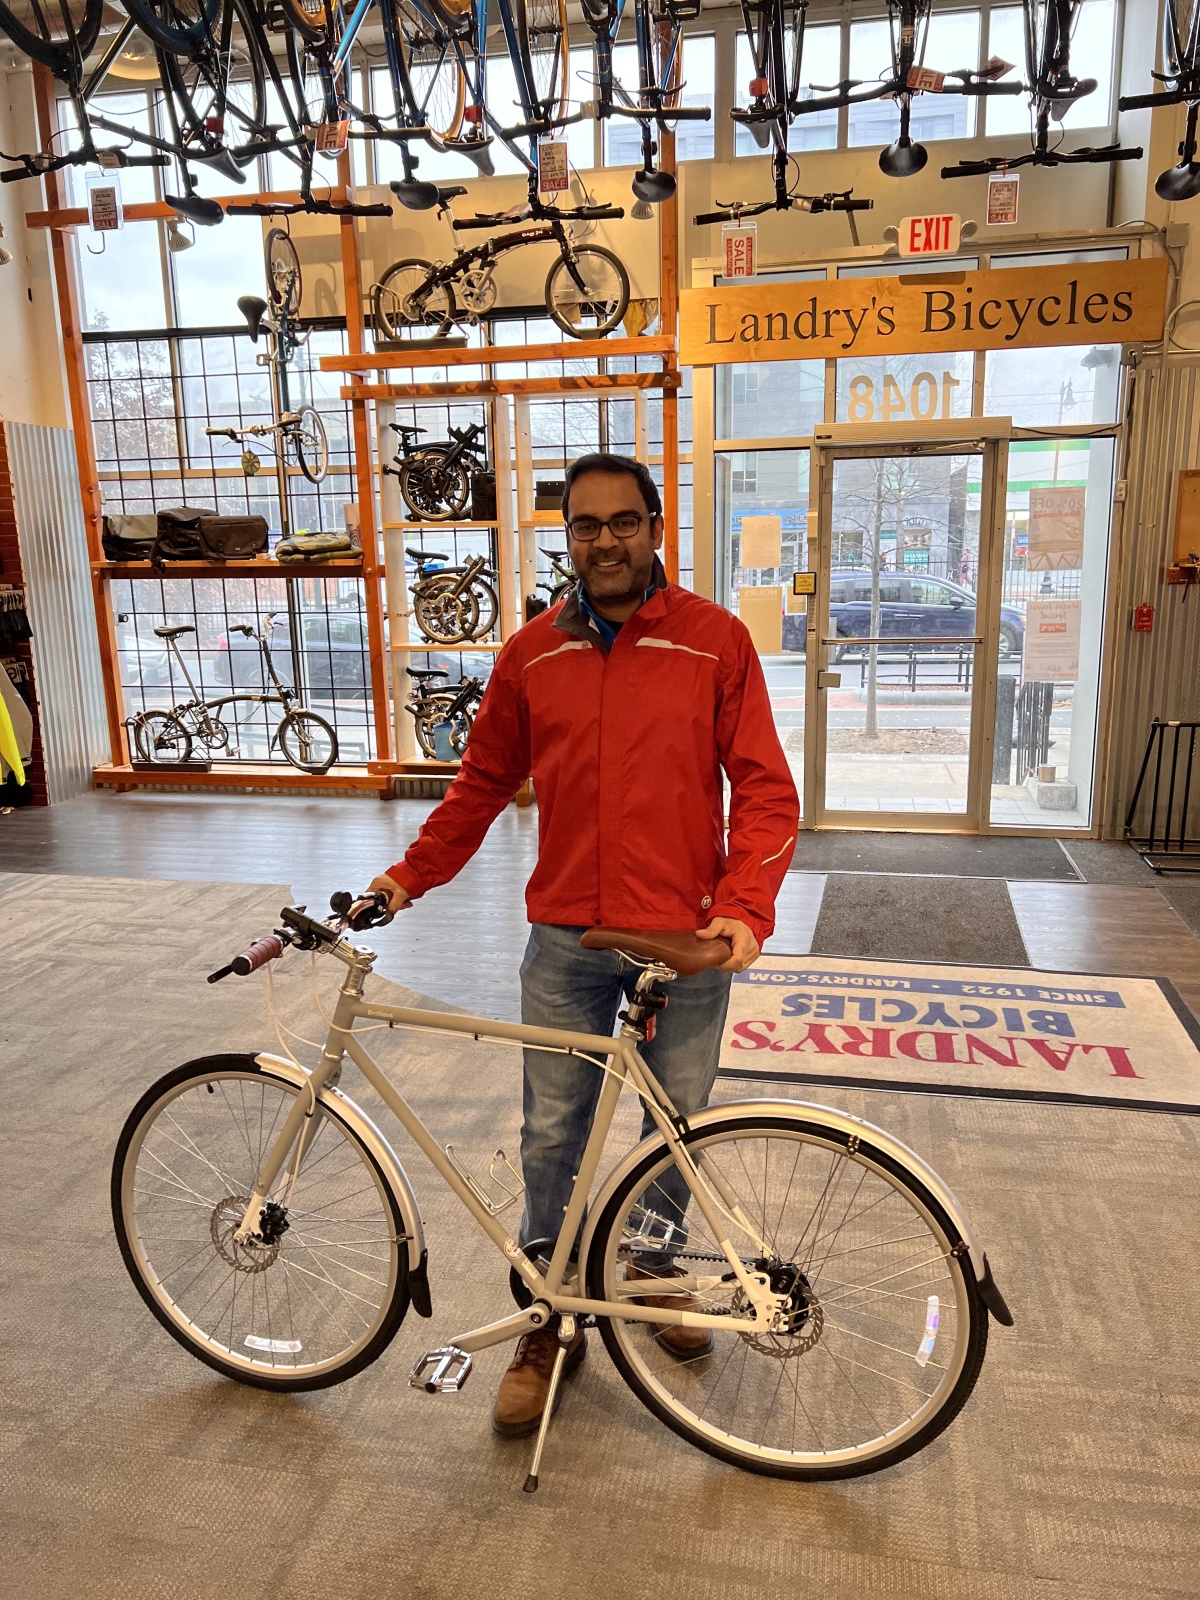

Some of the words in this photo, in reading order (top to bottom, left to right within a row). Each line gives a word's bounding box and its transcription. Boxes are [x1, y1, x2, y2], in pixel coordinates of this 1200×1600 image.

[543, 179, 566, 190] SALE
[96, 220, 117, 229] SALE
[991, 213, 1014, 222] SALE
[910, 216, 953, 252] EXIT
[734, 239, 745, 275] SALE
[705, 296, 896, 349] Landry's
[920, 280, 1133, 341] Bicycles
[749, 972, 911, 988] LANDRYS.COM
[961, 985, 1026, 997] 1922
[1038, 990, 1107, 1003] SINCE
[781, 993, 1076, 1037] BICYCLES
[730, 1020, 1145, 1079] LANDRY'S
